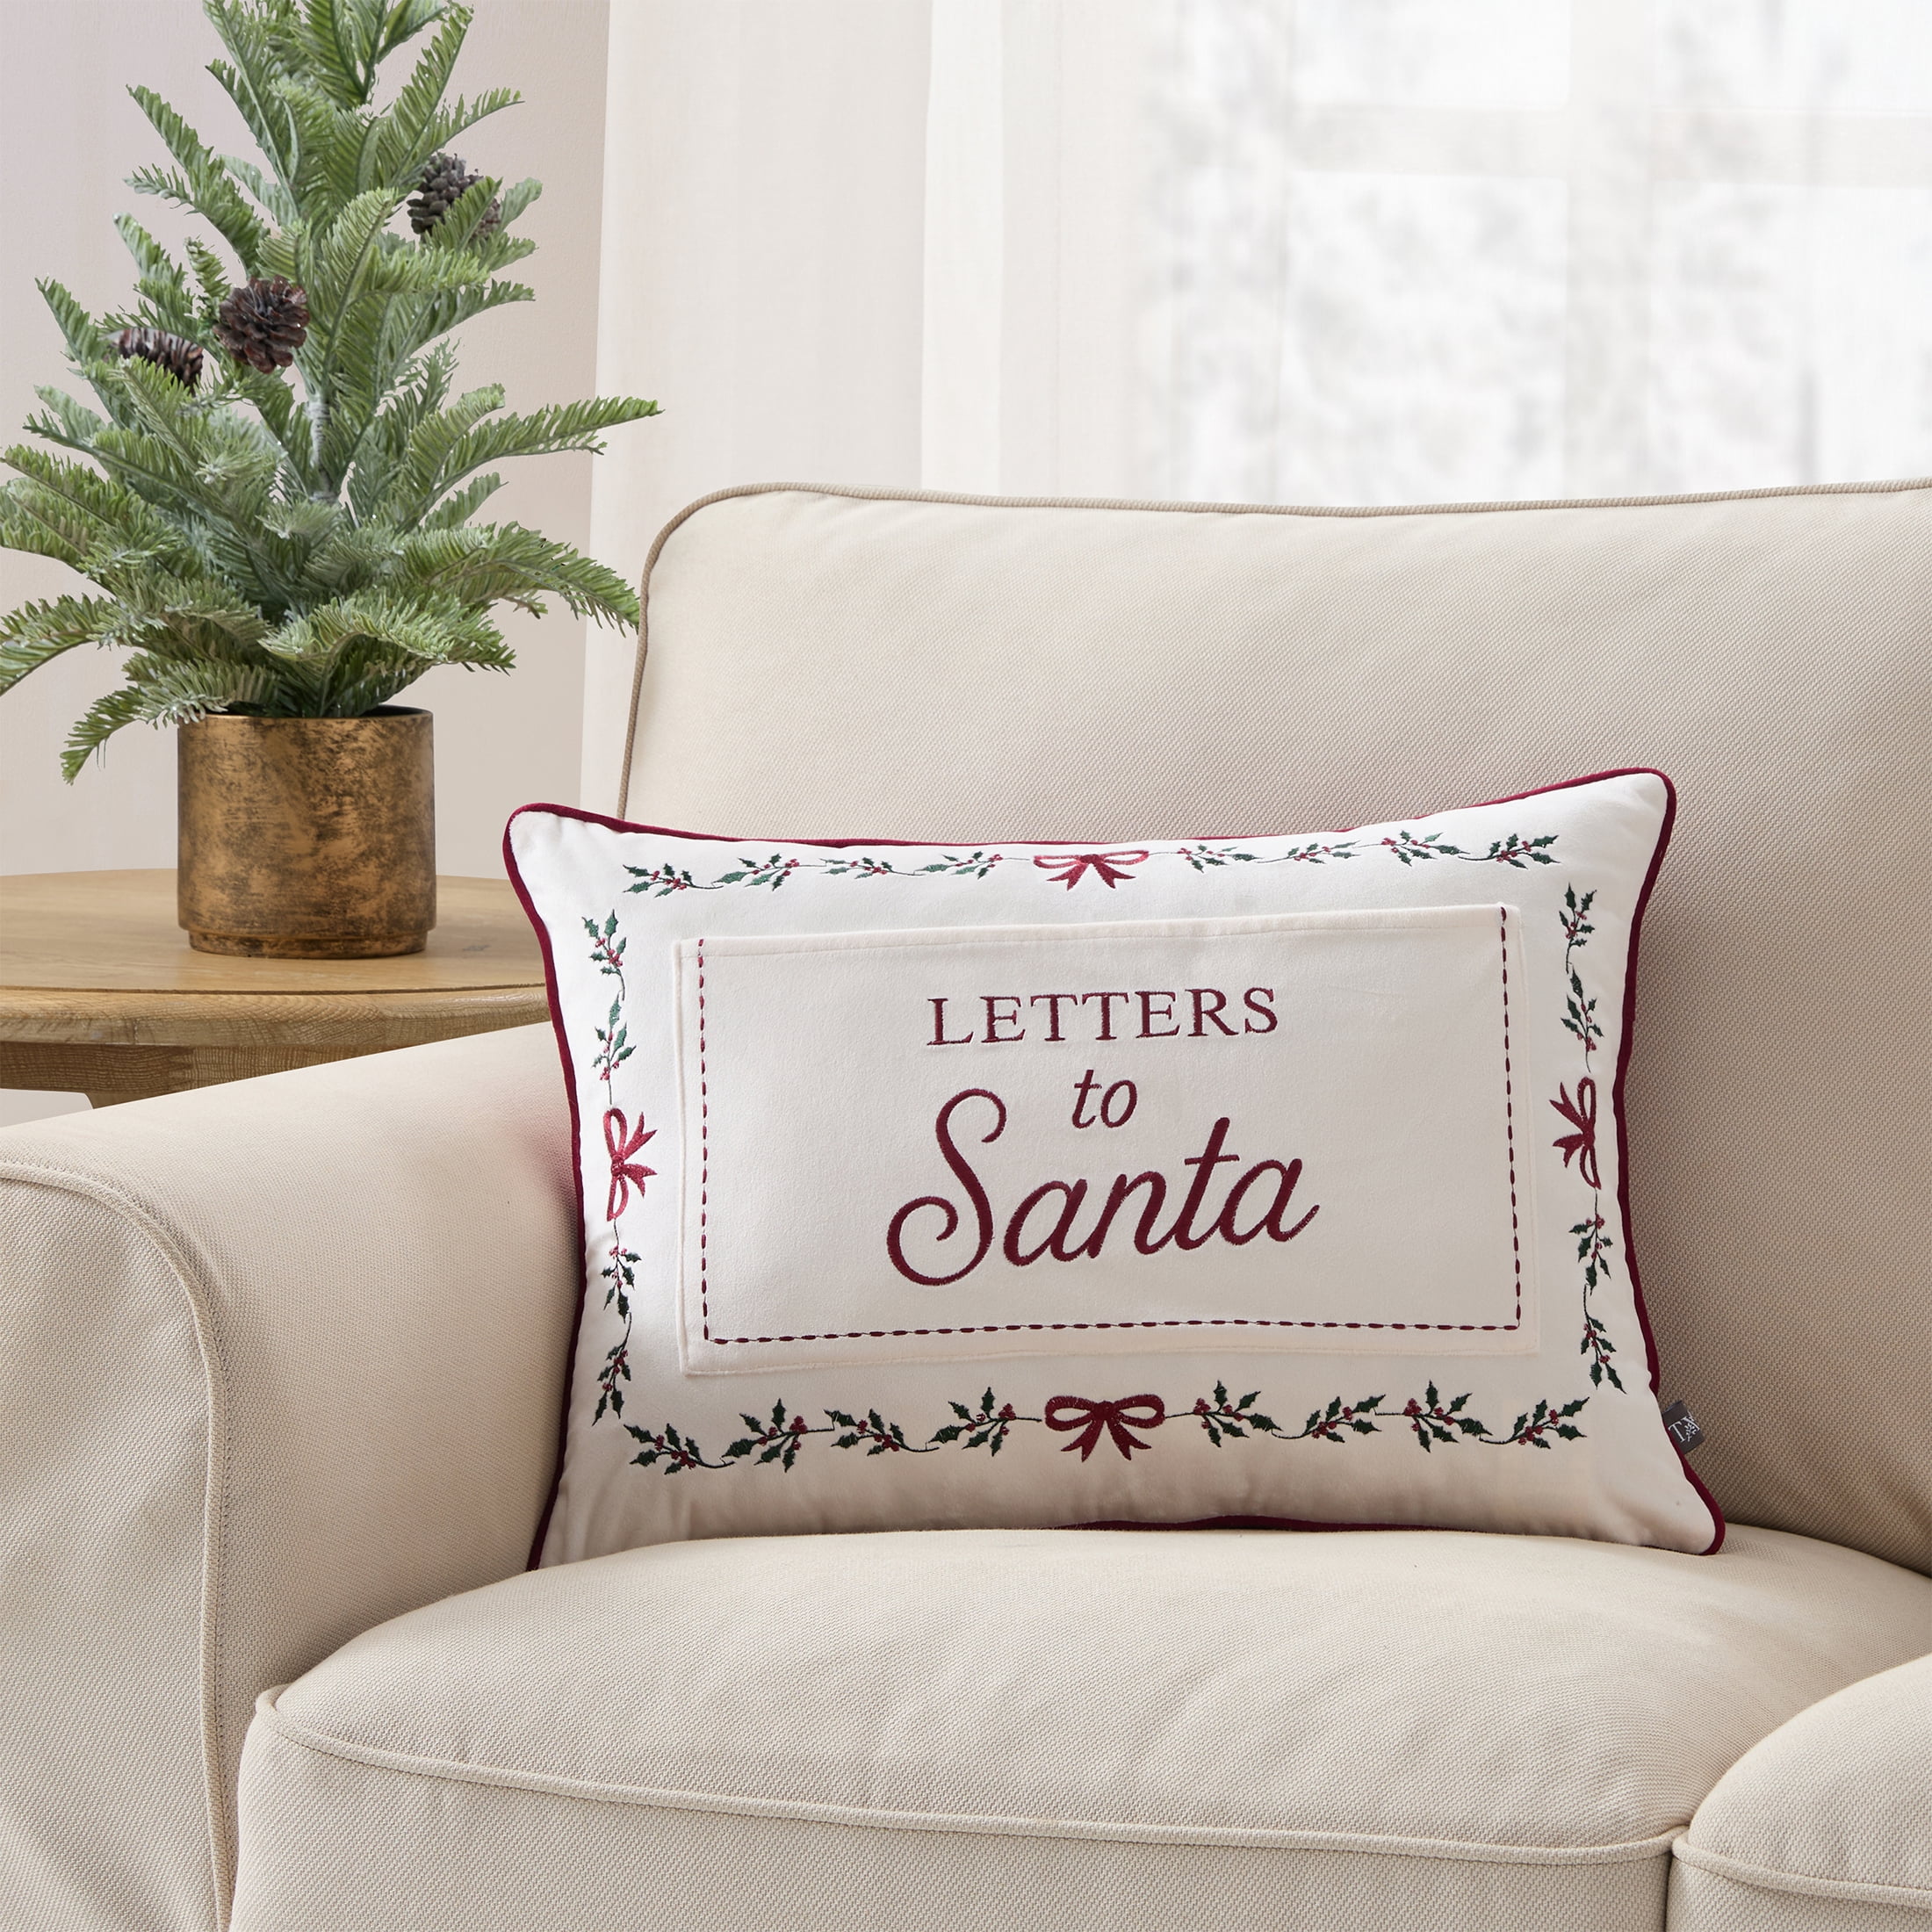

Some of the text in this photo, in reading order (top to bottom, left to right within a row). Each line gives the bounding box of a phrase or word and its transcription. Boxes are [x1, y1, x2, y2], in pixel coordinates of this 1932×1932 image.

[926, 986, 1279, 1046] LETTERS
[1071, 1069, 1138, 1129] to
[885, 1087, 1321, 1287] Santa
